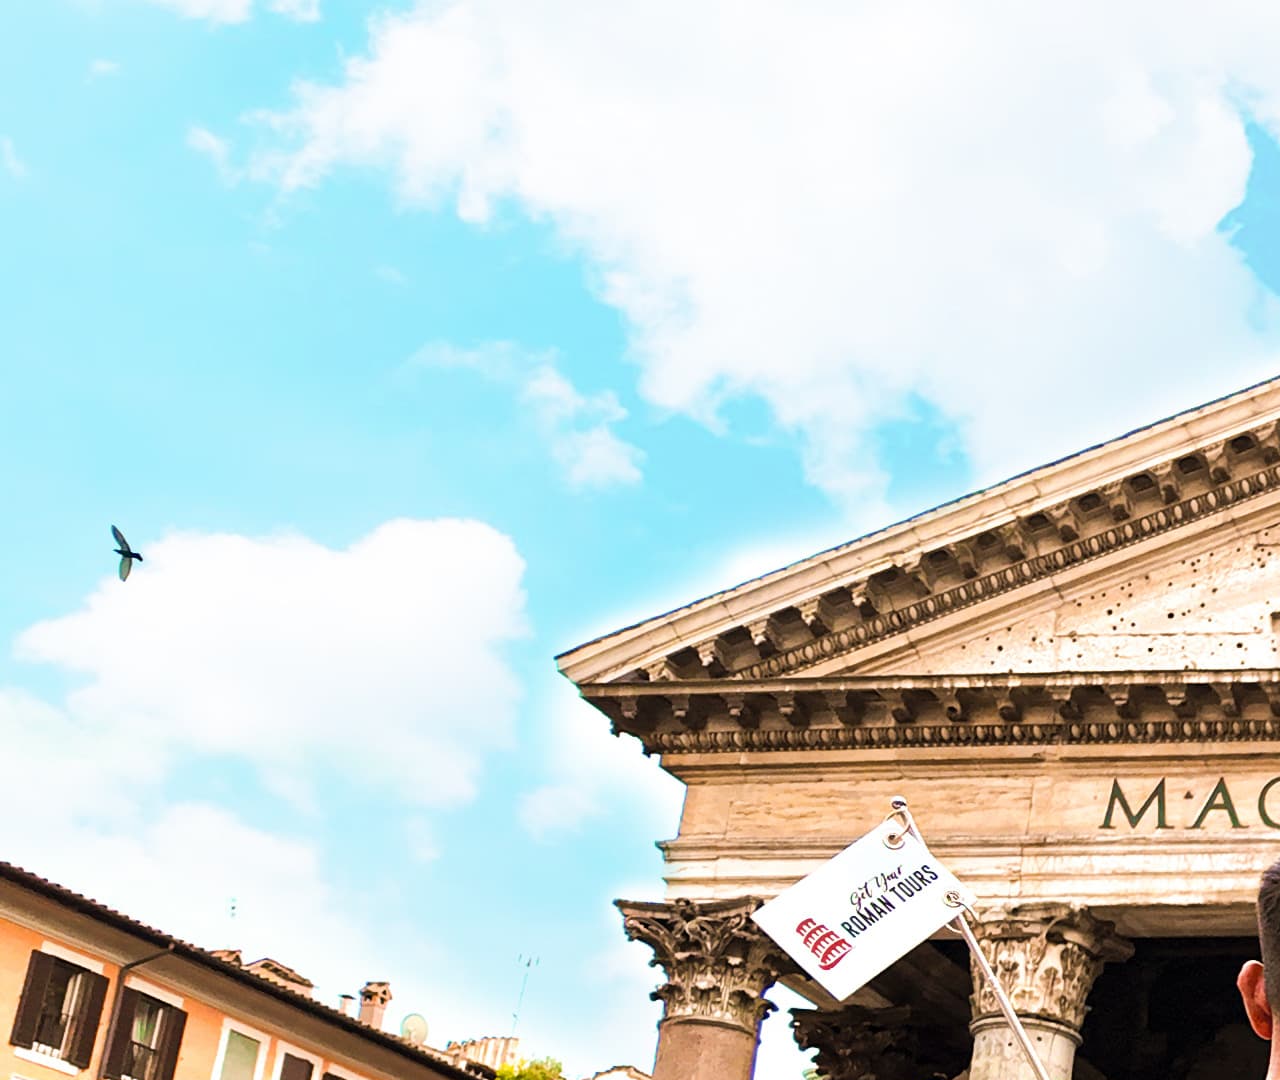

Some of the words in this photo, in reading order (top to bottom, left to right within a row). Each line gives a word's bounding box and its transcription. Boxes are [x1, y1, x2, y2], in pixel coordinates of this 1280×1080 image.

[841, 895, 896, 938] ROMAN
[889, 864, 938, 902] TOURS
[850, 881, 873, 912] Get
[870, 864, 902, 893] Your
